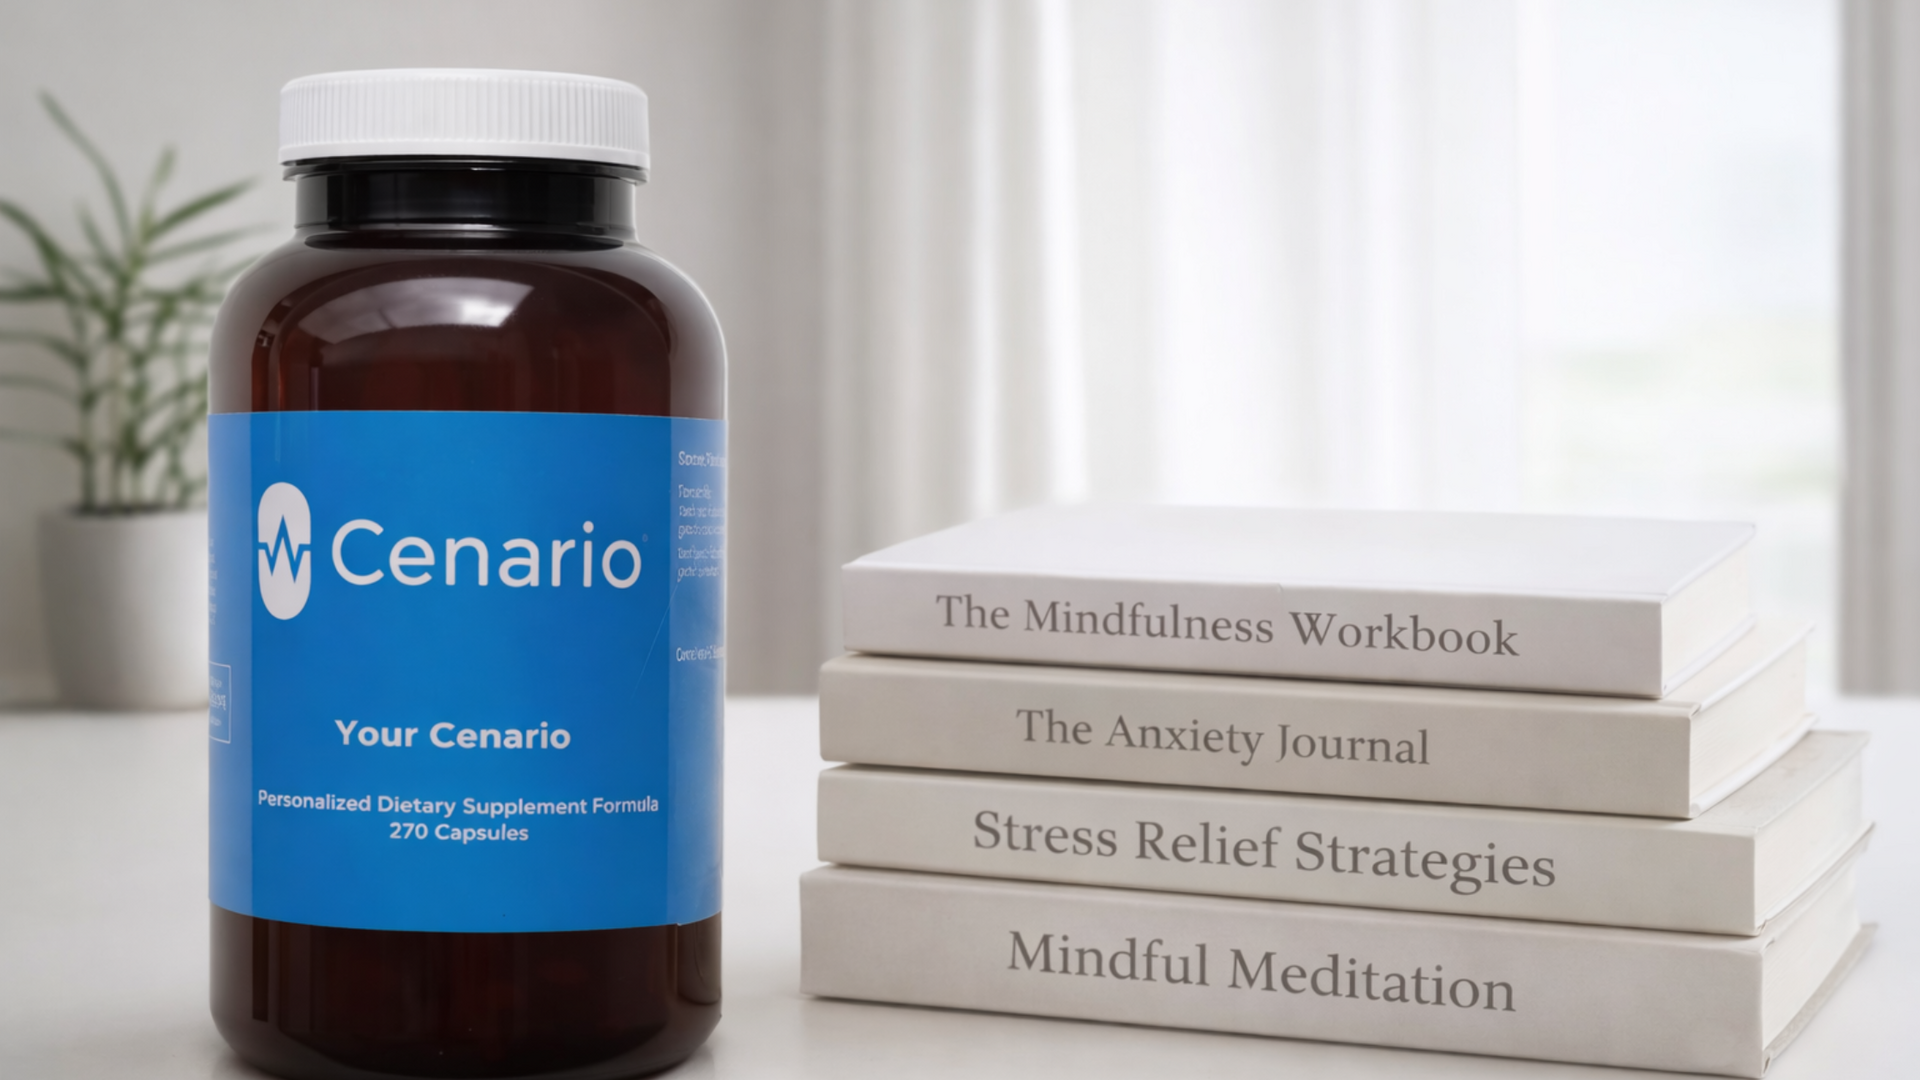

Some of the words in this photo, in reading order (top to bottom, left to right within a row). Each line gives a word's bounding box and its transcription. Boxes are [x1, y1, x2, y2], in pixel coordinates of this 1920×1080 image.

[936, 594, 1010, 630] The
[1025, 599, 1275, 645] Mindfulness
[1289, 611, 1521, 657] Workbook
[334, 719, 419, 748] Your
[429, 721, 571, 750] Cenario
[1016, 708, 1092, 745] The
[1105, 715, 1264, 767] Anxiety
[1276, 724, 1429, 765] Journal
[258, 789, 372, 812] Personalized
[377, 795, 457, 817] Dietary
[462, 797, 588, 819] Supplement
[592, 795, 660, 814] Formula
[389, 821, 429, 840] 270
[434, 823, 529, 845] Capsules
[974, 810, 1118, 858] Stress
[1136, 821, 1282, 868] Relief
[1294, 831, 1556, 895] Strategies
[1008, 931, 1209, 987] Mindful
[1228, 949, 1516, 1012] Meditation
